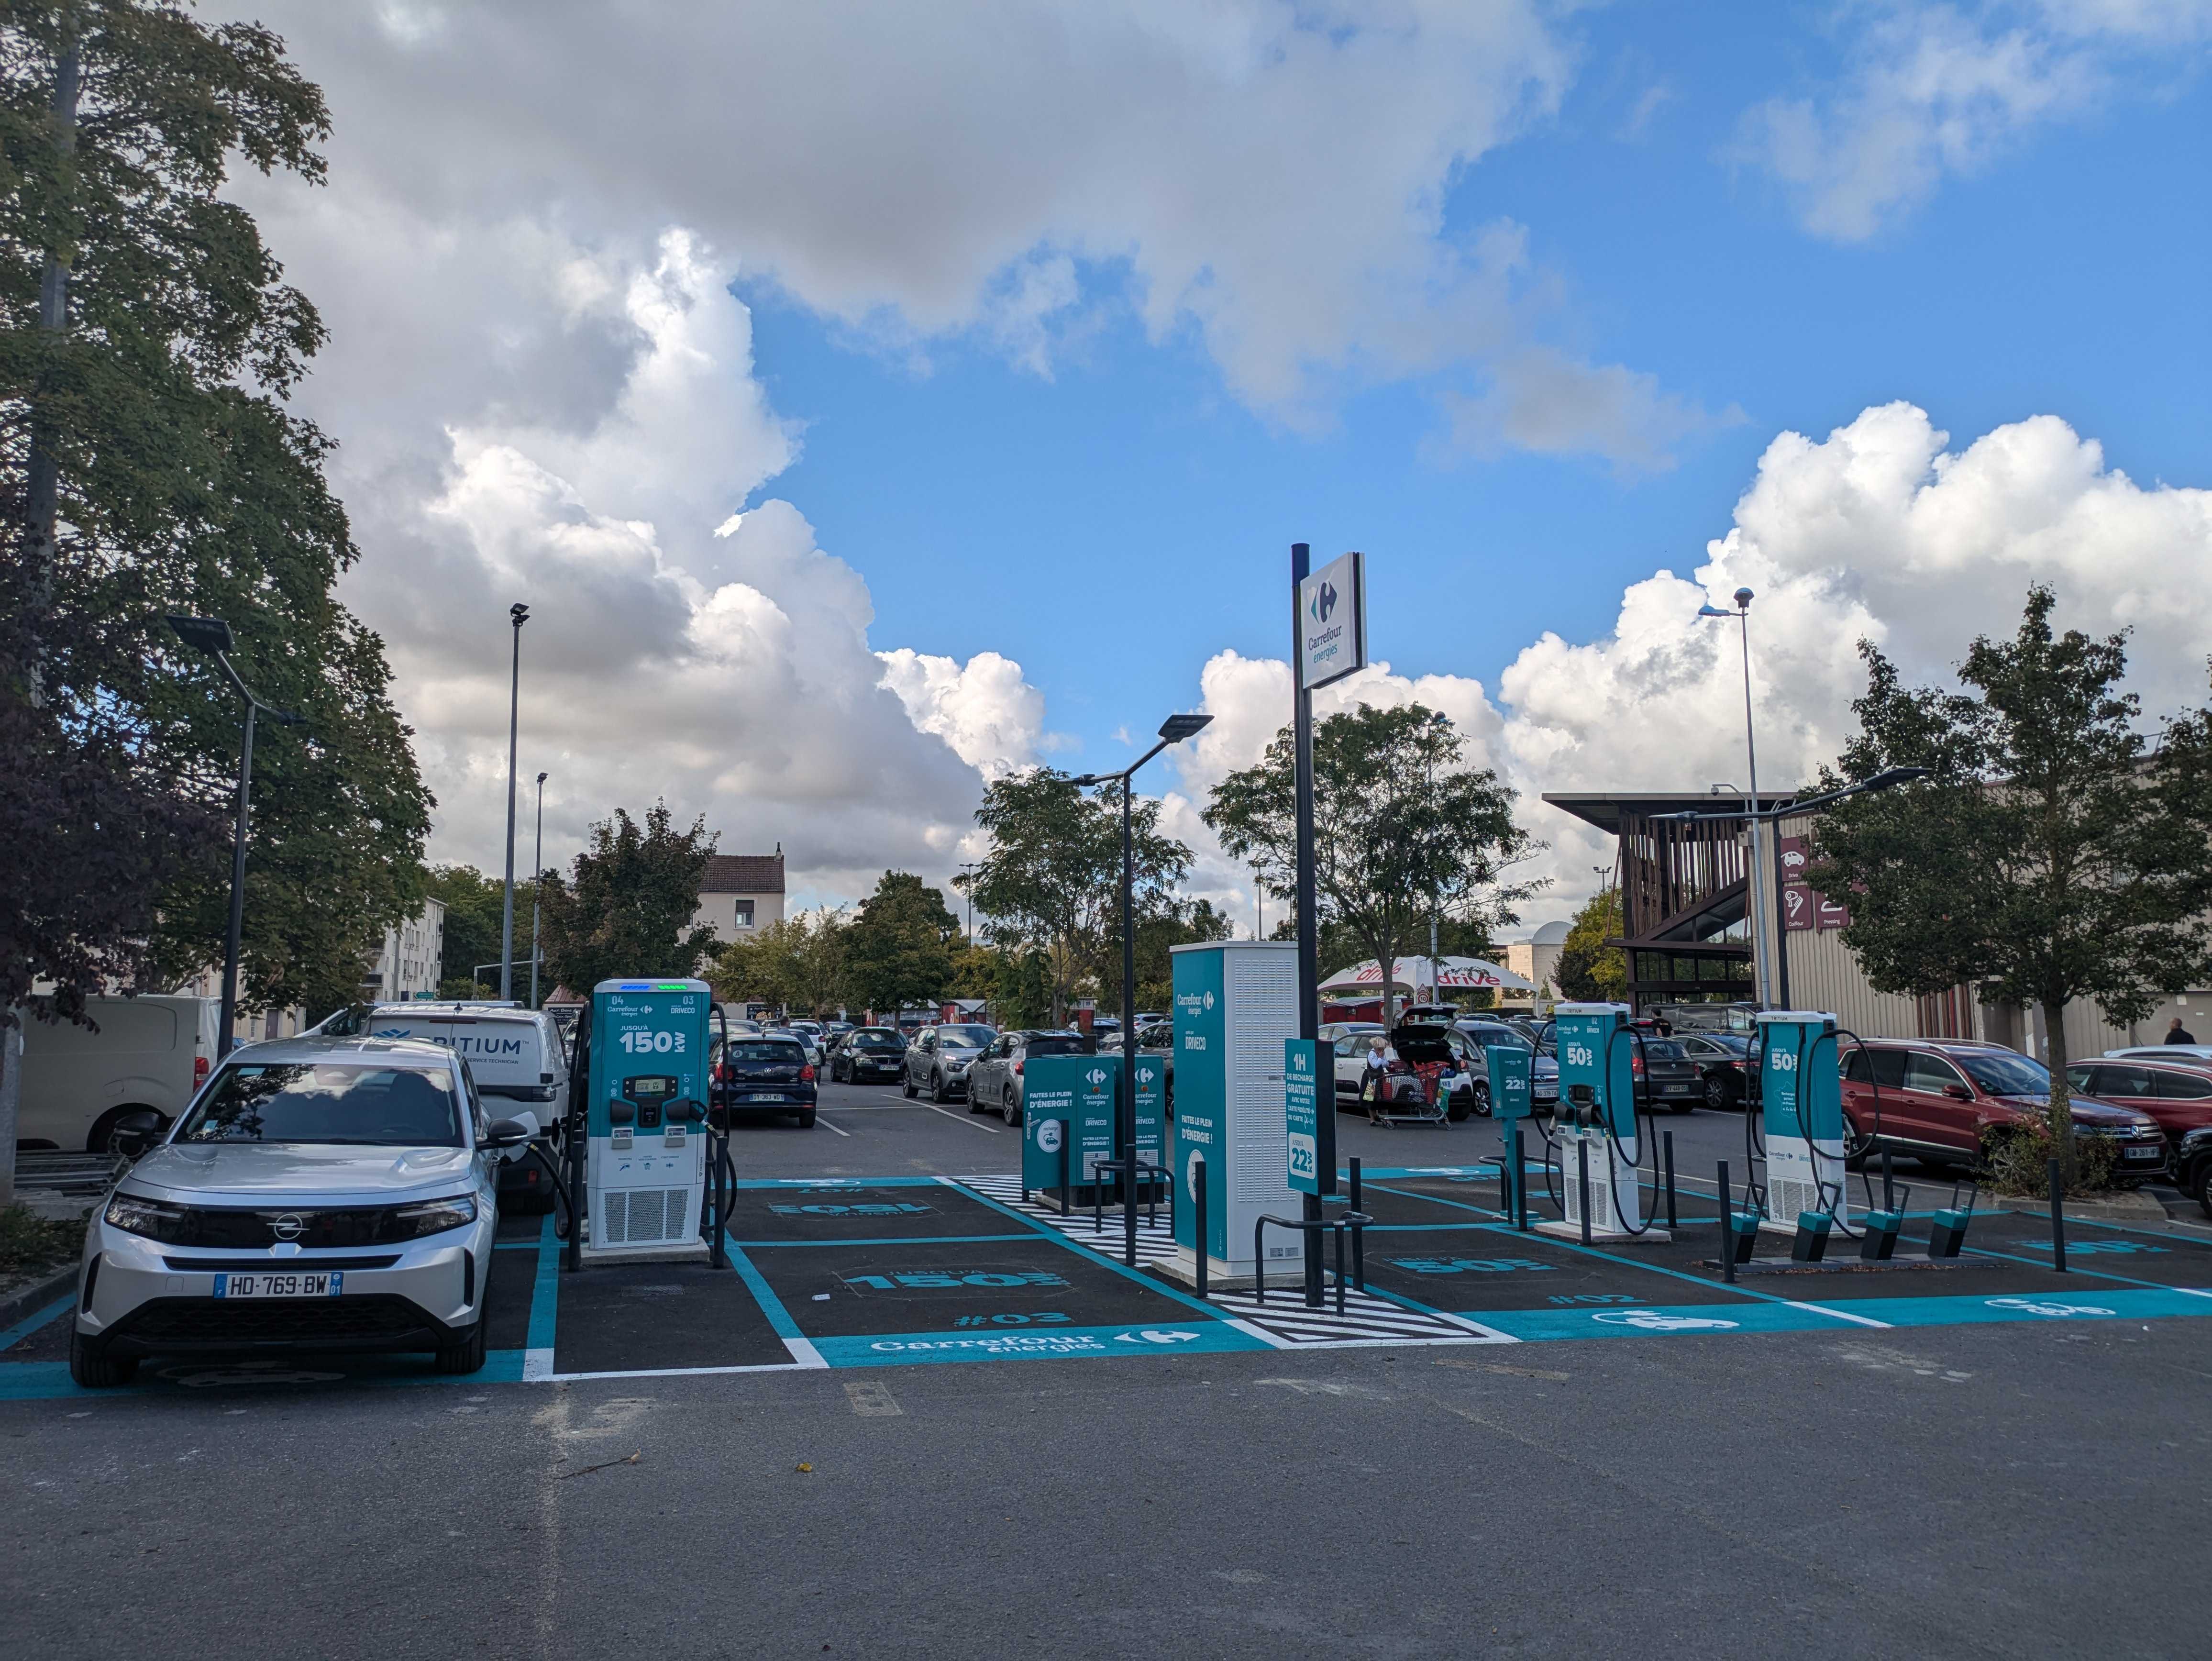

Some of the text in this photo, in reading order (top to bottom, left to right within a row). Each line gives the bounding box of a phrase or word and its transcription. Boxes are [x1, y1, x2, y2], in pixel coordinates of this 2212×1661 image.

[1308, 625, 1342, 651] Carrefour
[1313, 643, 1338, 663] énergies
[1356, 963, 1402, 981] drie
[1438, 973, 1501, 986] drive
[611, 996, 624, 1005] 04
[683, 996, 694, 1005] 03
[1177, 993, 1202, 1006] Carrefour
[421, 1036, 520, 1055] RITIUM
[619, 1031, 686, 1052] 150 kW
[1185, 1036, 1206, 1051] DRIVECO
[1294, 1053, 1306, 1071] 1H
[1567, 1047, 1593, 1066] 50 kW
[1771, 1053, 1792, 1071] 50
[1293, 1074, 1314, 1083] RECHARGE
[1505, 1079, 1520, 1089] 22
[1287, 1083, 1314, 1096] GRATUITE
[1029, 1098, 1069, 1108] D'ÉNERGIE
[1182, 1115, 1212, 1128] FAITES LE PLEIN
[1182, 1126, 1210, 1144] D'ÉNERGIE
[1292, 1148, 1307, 1172] 22
[800, 1204, 933, 1214] 150
[1391, 1259, 1516, 1273] 50
[230, 1275, 327, 1295] HD-769-BW
[844, 1274, 1029, 1289] 150
[331, 1285, 340, 1294] 01
[1547, 1294, 1649, 1305] #02
[954, 1312, 1072, 1326] #03
[871, 1336, 1095, 1351] Carrefour
[987, 1343, 1106, 1352] énergies
